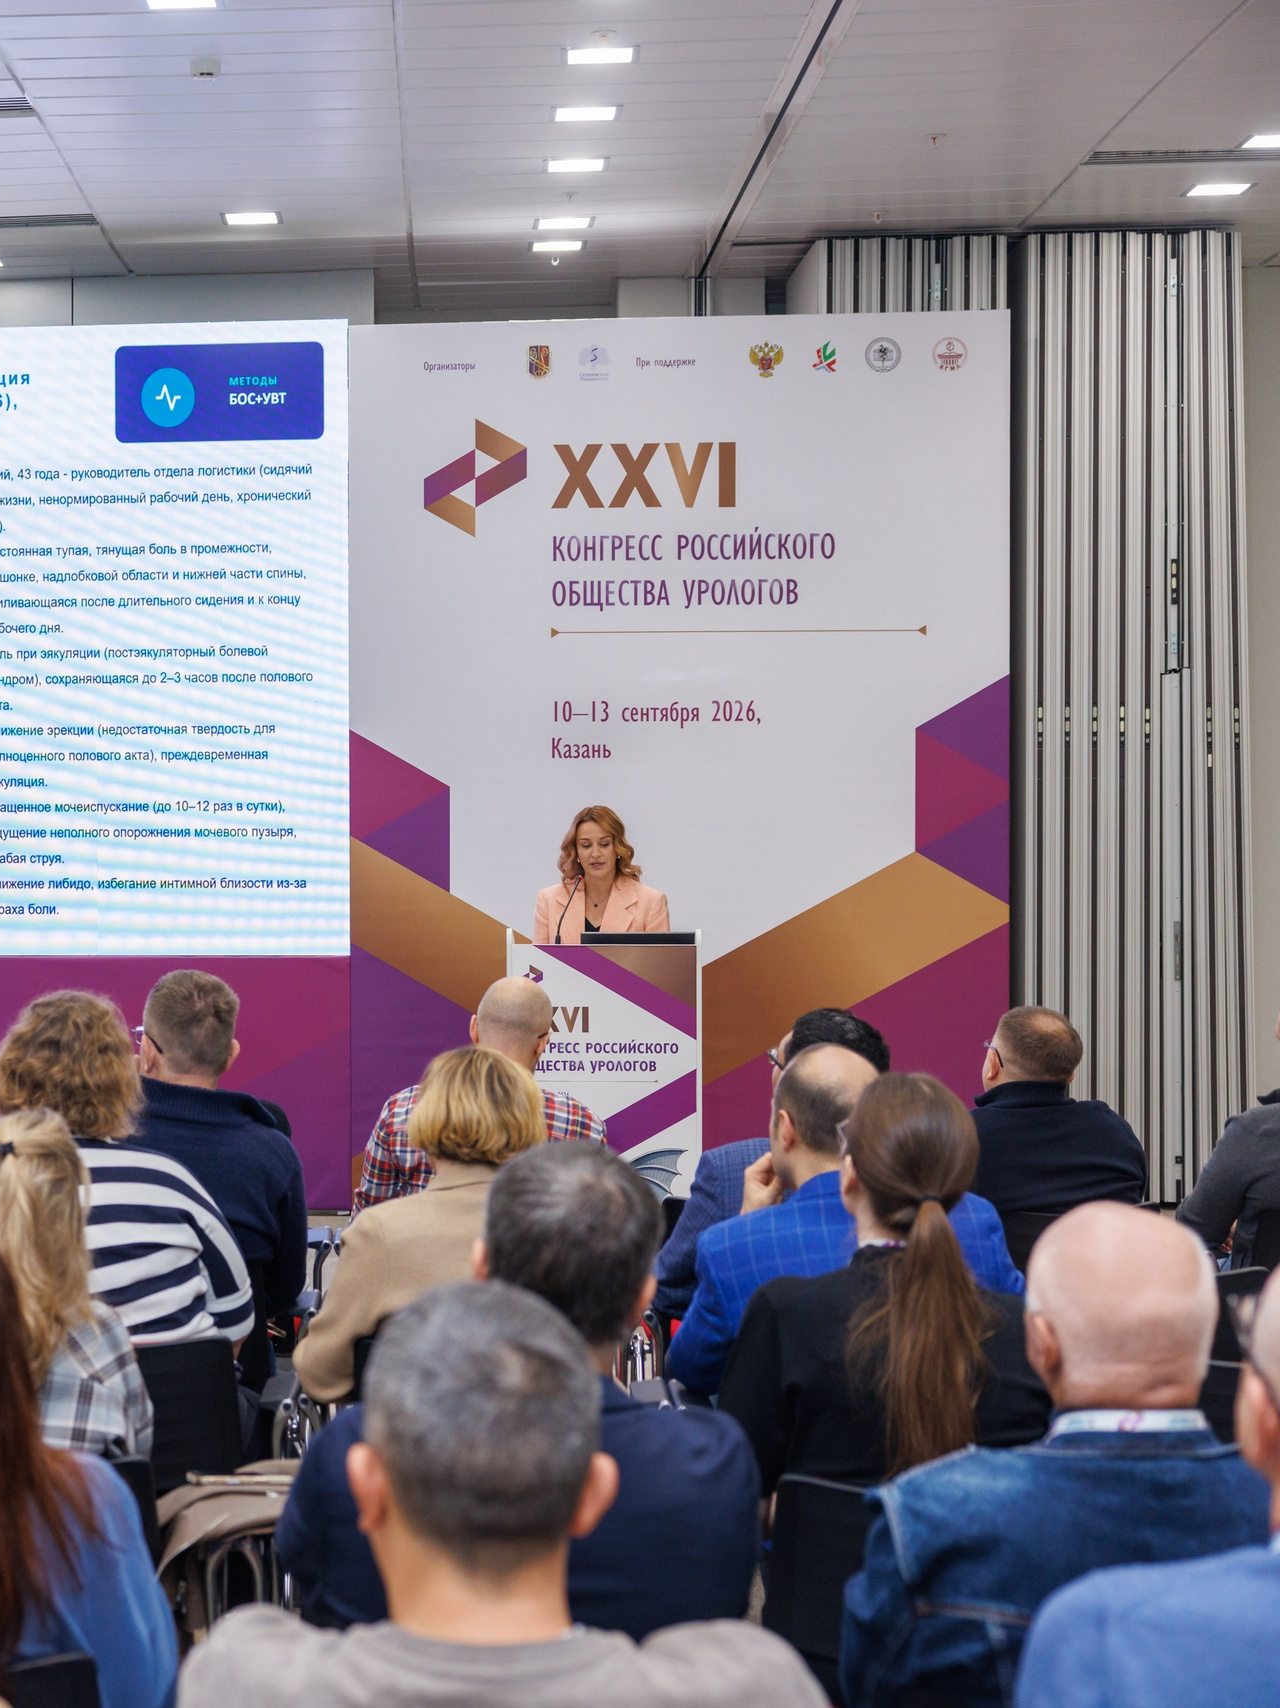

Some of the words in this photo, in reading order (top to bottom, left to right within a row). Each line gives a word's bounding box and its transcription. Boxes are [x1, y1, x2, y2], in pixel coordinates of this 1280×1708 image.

[424, 361, 475, 373] Организаторы
[636, 357, 650, 369] При
[655, 359, 696, 369] поддержке
[229, 376, 277, 387] МЕТОДЫ
[230, 391, 287, 405] БОС+УВТ
[17, 469, 31, 480] 43
[35, 470, 59, 480] года
[71, 469, 150, 482] руководитель
[154, 468, 194, 478] отдела
[198, 467, 255, 477] логистики
[260, 464, 312, 478] (сидячий
[552, 442, 736, 508] XXVI
[553, 535, 662, 561] КОНГРЕСС
[678, 526, 835, 561] РОССИЙСКОГО
[56, 547, 91, 559] тупая,
[96, 546, 145, 557] тянущая
[149, 543, 177, 555] боль
[181, 545, 187, 554] в
[191, 544, 271, 556] промежности,
[552, 580, 669, 611] ОБЩЕСТВА
[683, 579, 798, 609] УРОЛОГОВ
[81, 598, 115, 607] после
[118, 597, 191, 609] длительного
[195, 596, 244, 607] сидения
[248, 596, 254, 604] и
[259, 596, 264, 604] к
[268, 596, 300, 607] концу
[39, 624, 63, 635] дня.
[17, 650, 37, 661] при
[40, 649, 100, 662] эякуляции
[104, 646, 215, 660] (постэякуляторный
[219, 645, 268, 656] болевой
[45, 675, 138, 687] сохраняющаяся
[142, 674, 156, 686] до
[185, 674, 218, 683] часов
[222, 674, 256, 683] после
[260, 672, 313, 682] полового
[622, 701, 699, 728] сентября
[712, 700, 761, 725] 2026,
[47, 727, 94, 738] эрекции
[98, 725, 187, 738] (недостаточная
[191, 725, 250, 737] твердость
[253, 725, 275, 736] для
[552, 737, 611, 759] Казань
[54, 802, 150, 814] мочеиспускание
[153, 801, 171, 814] (до
[214, 803, 233, 814] раз
[236, 803, 243, 811] в
[246, 800, 285, 814] сутки),
[30, 855, 64, 866] струя.
[48, 878, 93, 890] либидо,
[98, 878, 156, 889] избегание
[161, 878, 216, 889] интимной
[221, 877, 273, 888] близости
[277, 880, 306, 888] из-за
[28, 903, 58, 914] боли.
[543, 1042, 580, 1054] РЕСС
[585, 1039, 679, 1054] РОССИЙСКОГО
[535, 1060, 585, 1074] ЩЕСТВА
[590, 1060, 657, 1074] УРОЛОГОВ
